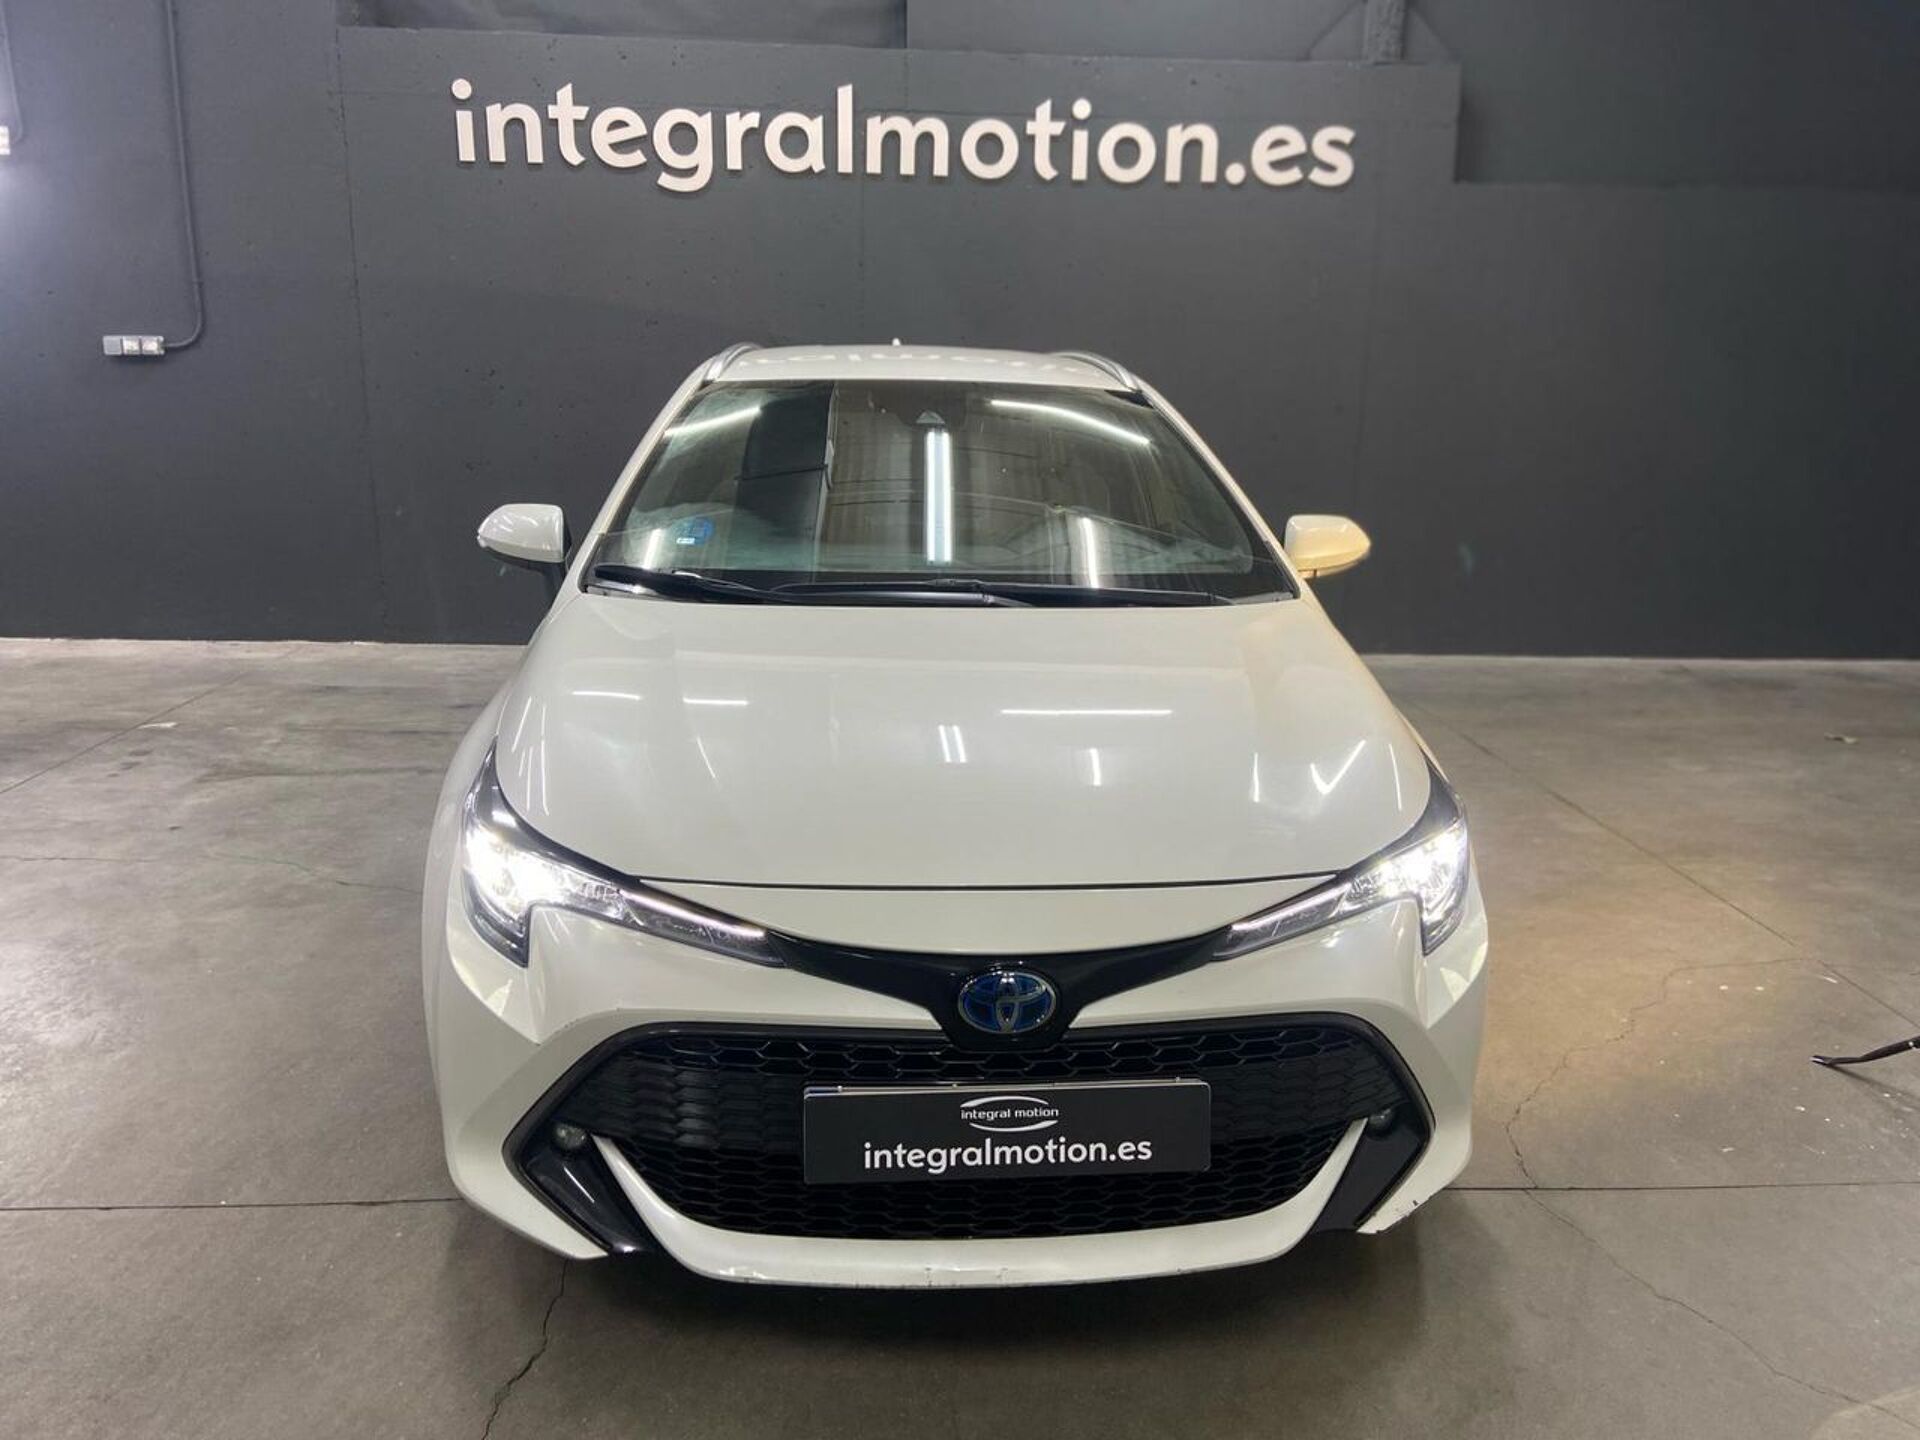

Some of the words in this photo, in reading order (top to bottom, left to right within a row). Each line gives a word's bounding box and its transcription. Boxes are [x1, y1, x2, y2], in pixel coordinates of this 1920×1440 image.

[451, 78, 1356, 193] integralmotion.es
[961, 1108, 1011, 1121] integral
[1014, 1106, 1060, 1118] motion
[864, 1136, 1152, 1174] integralmotion.es
